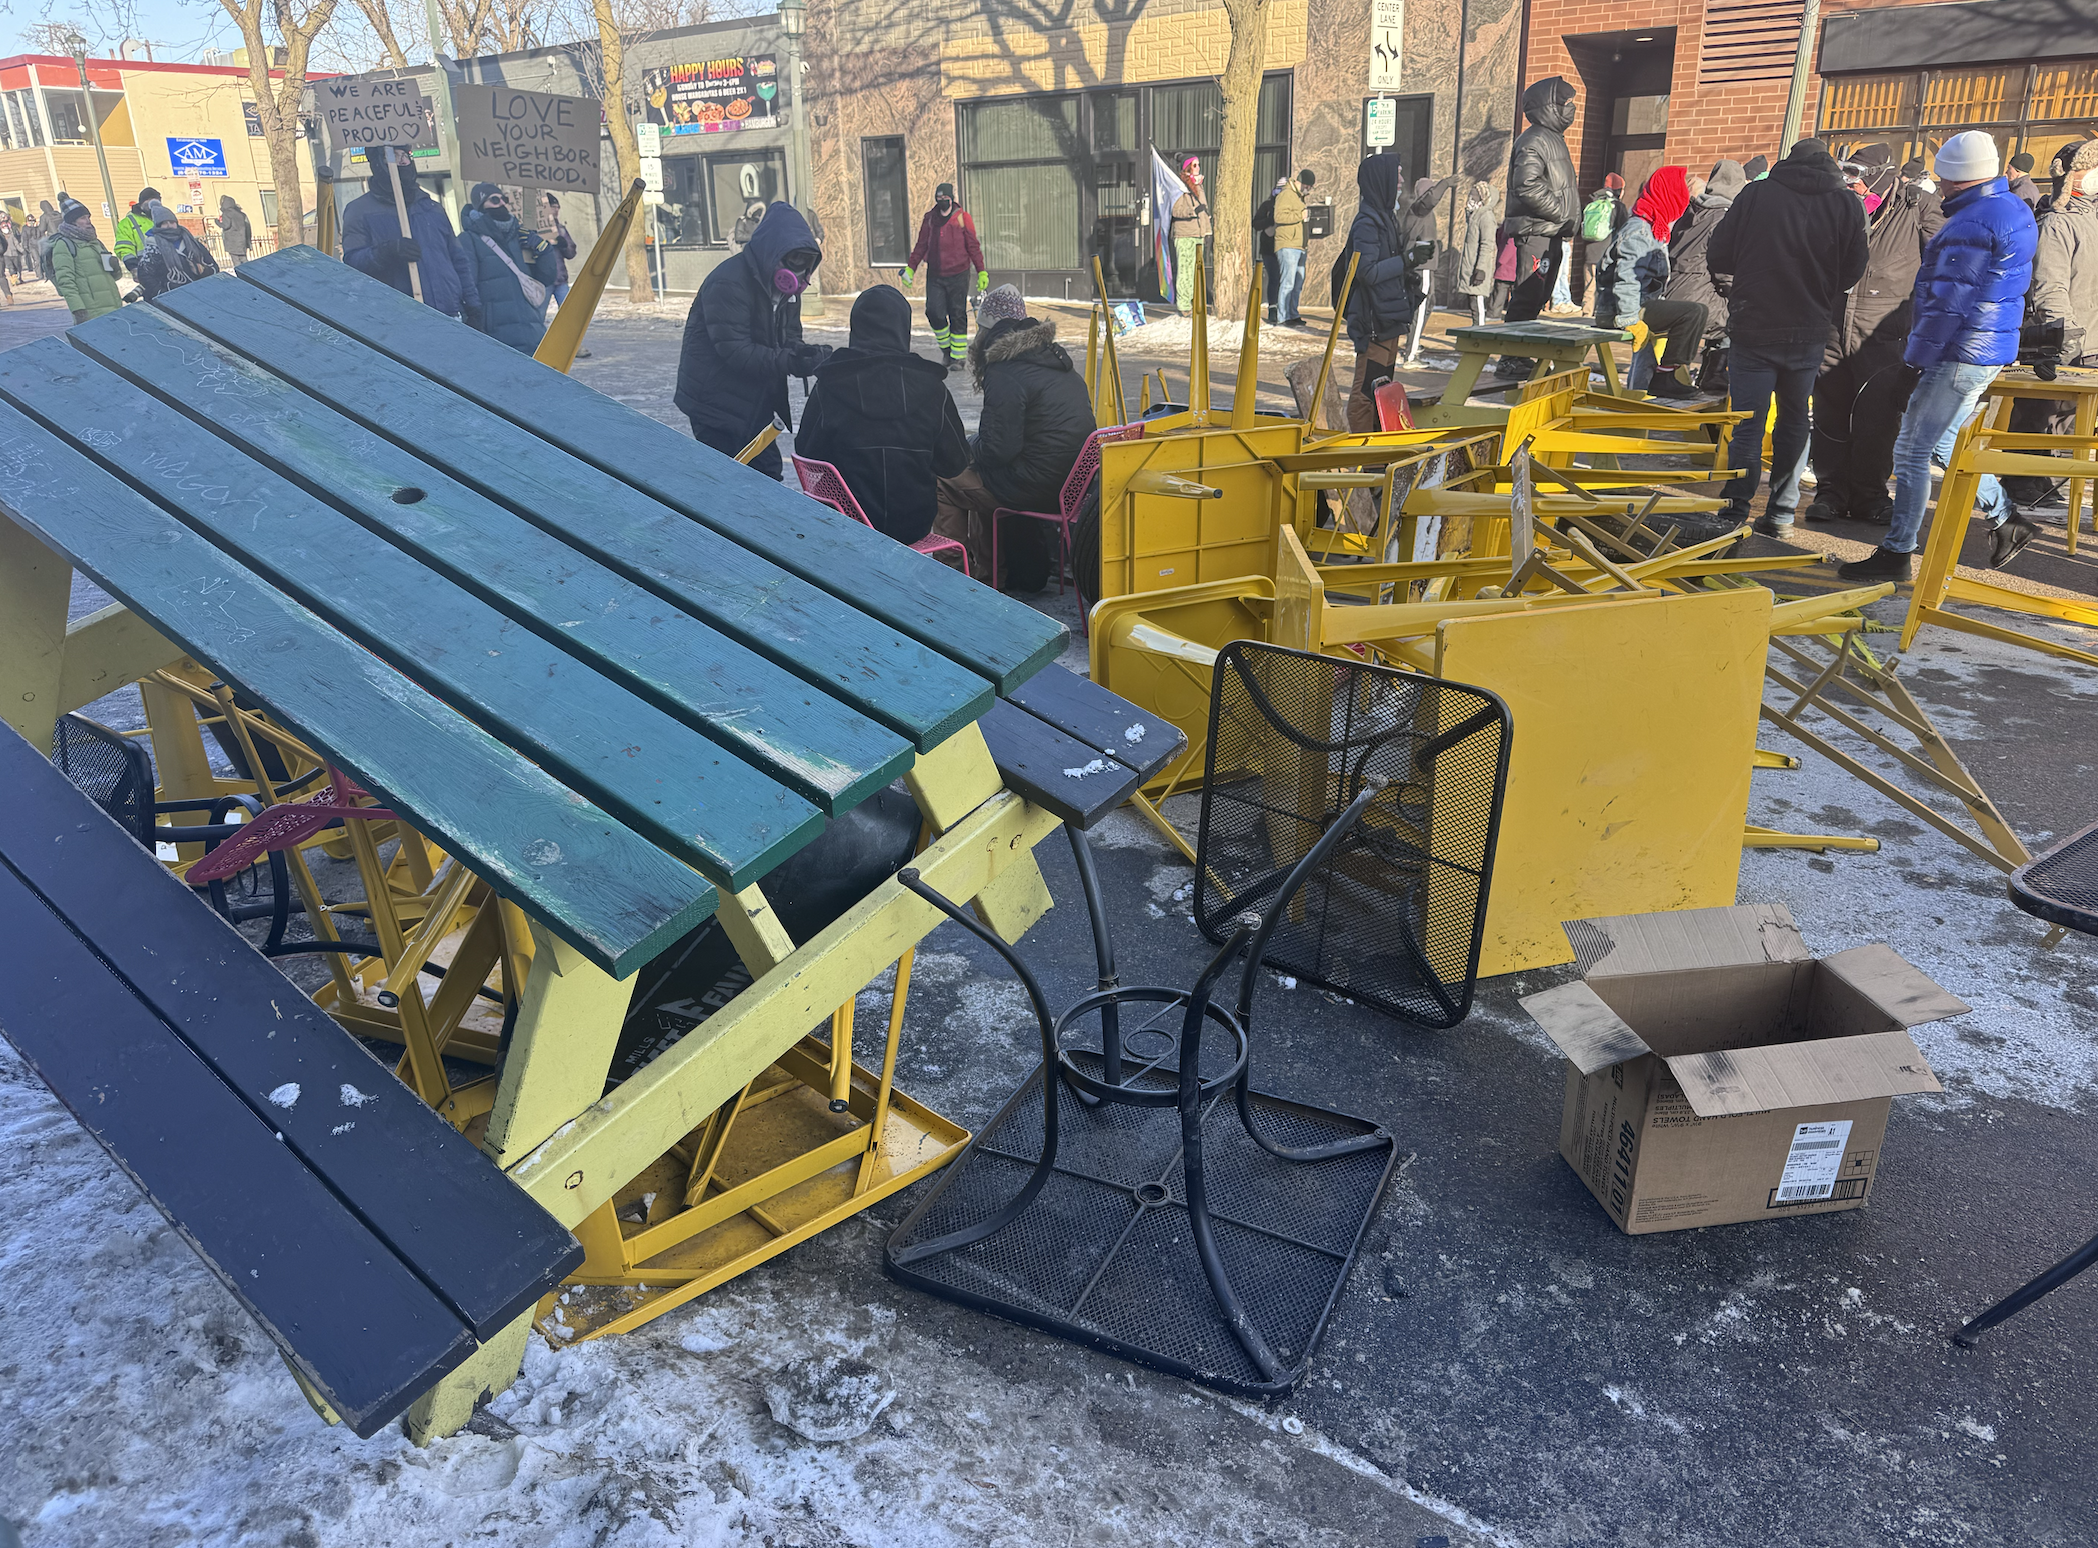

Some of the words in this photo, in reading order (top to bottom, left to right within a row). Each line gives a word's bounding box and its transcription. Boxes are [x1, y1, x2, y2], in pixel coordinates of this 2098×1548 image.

[1377, 2, 1400, 13] CENTER
[1380, 14, 1396, 24] LANE
[669, 61, 705, 83] HAPPY
[707, 57, 744, 80] HOURS
[329, 85, 359, 98] WE
[371, 82, 407, 97] ARE
[1377, 76, 1394, 85] ONLY
[329, 103, 415, 123] PEACEFUL
[492, 90, 575, 128] LOVE
[342, 125, 399, 145] PROUD
[496, 122, 558, 142] YOUR
[184, 147, 207, 159] AM
[473, 138, 598, 169] NEIGHBOR.
[503, 161, 587, 186] PERIOD.
[625, 1036, 656, 1065] MILLS
